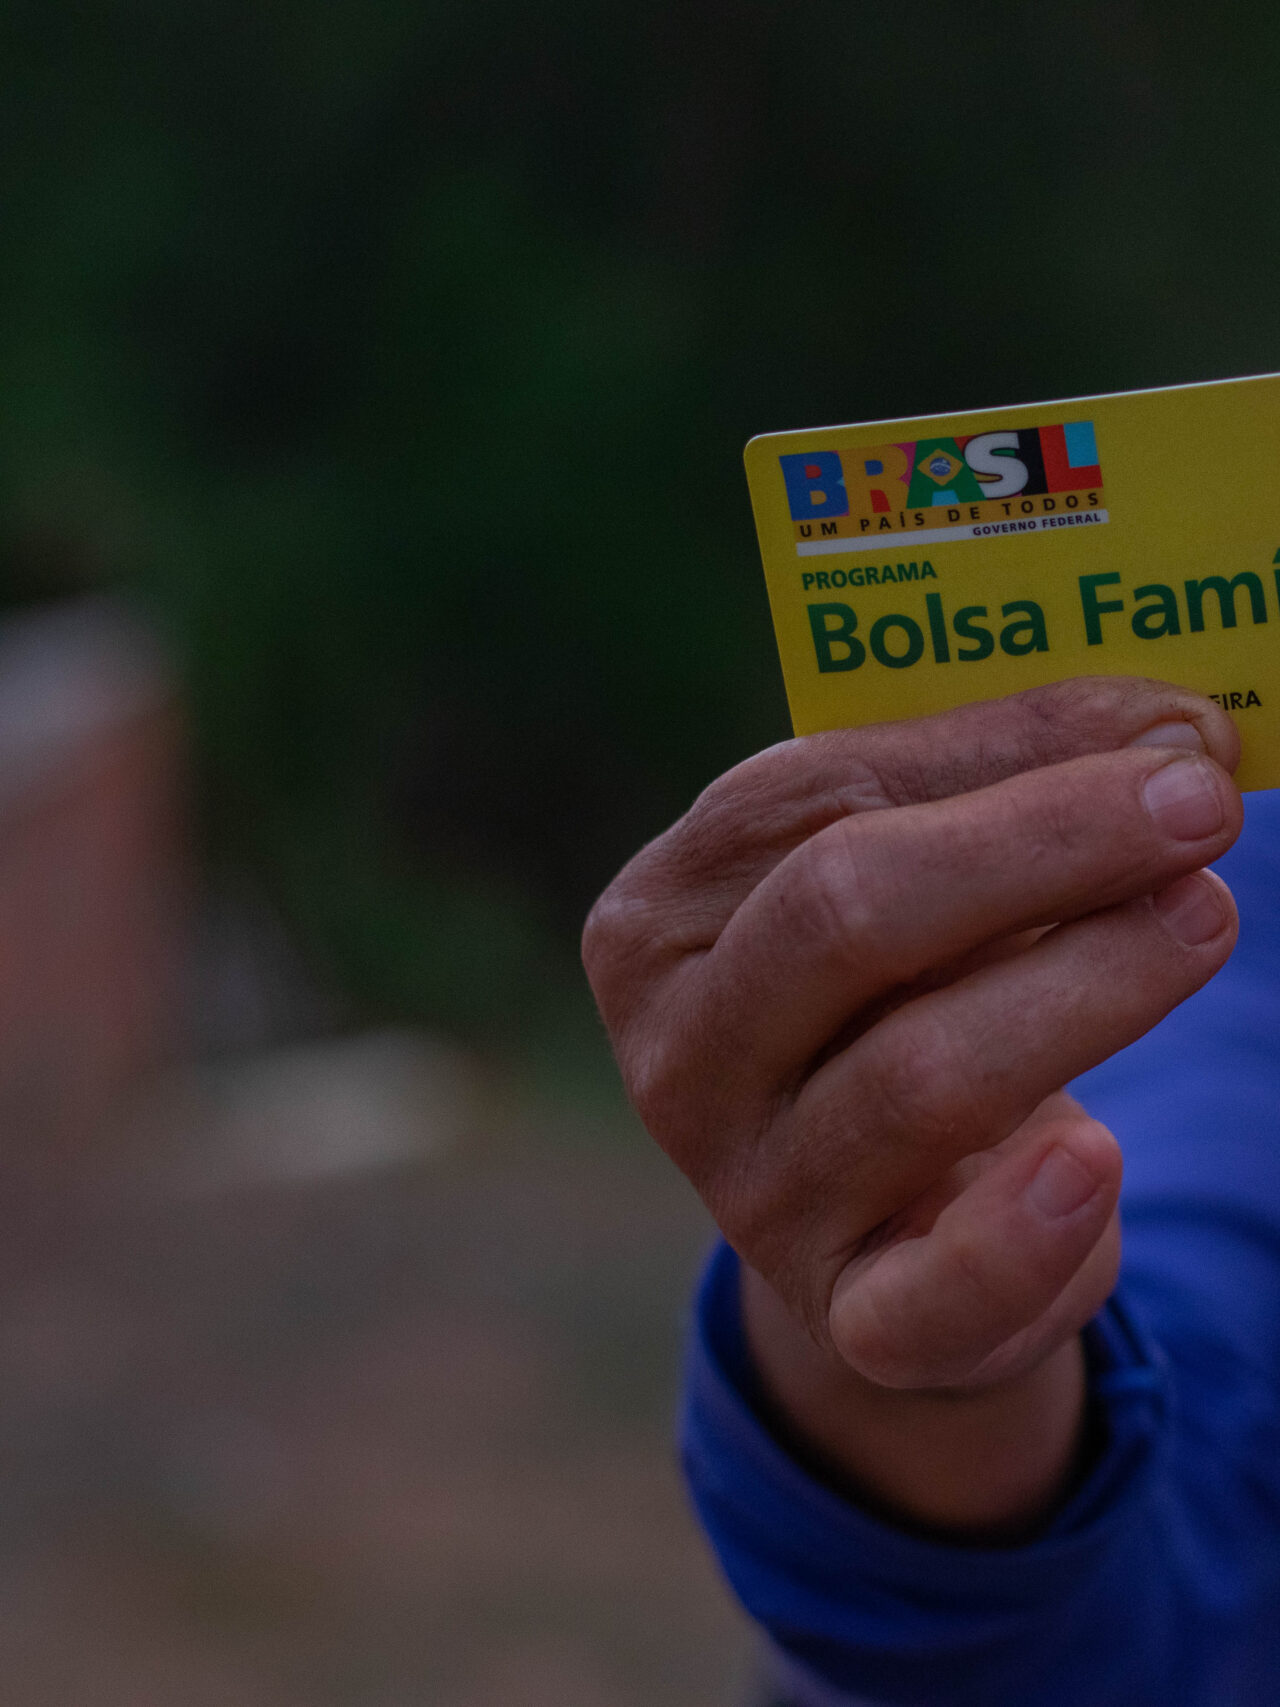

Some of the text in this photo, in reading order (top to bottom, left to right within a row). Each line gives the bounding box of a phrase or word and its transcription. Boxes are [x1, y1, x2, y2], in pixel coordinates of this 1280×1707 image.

[779, 421, 1103, 521] BRASIL
[800, 492, 1098, 538] UM PAÍS DE TODOS
[973, 513, 1101, 536] GOVERNO FEDERAL
[802, 560, 938, 591] PROGRAMA
[807, 592, 1050, 674] Bolsa
